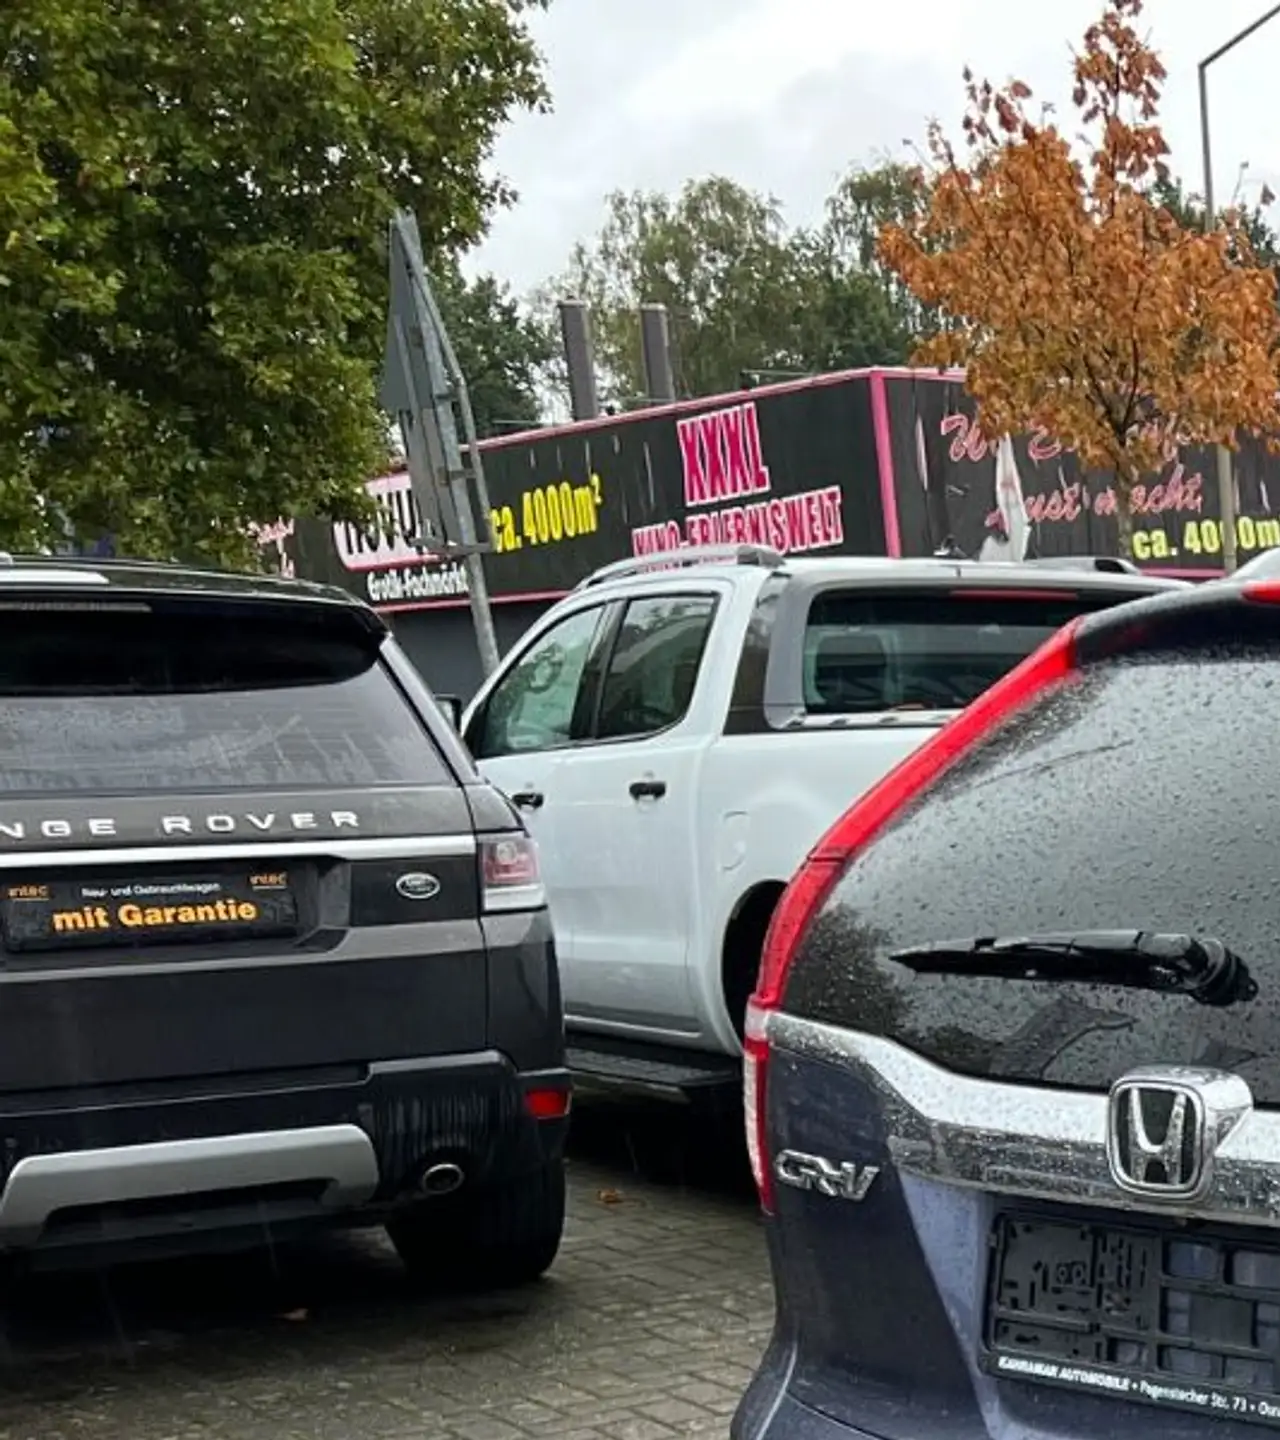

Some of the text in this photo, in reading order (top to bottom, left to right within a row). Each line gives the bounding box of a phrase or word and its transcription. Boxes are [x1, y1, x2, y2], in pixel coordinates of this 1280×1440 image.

[676, 402, 771, 507] XXXL
[1131, 528, 1178, 560] ca.
[161, 811, 360, 835] ROVER
[53, 898, 259, 932] mit Garantie
[1232, 1396, 1248, 1413] 73
